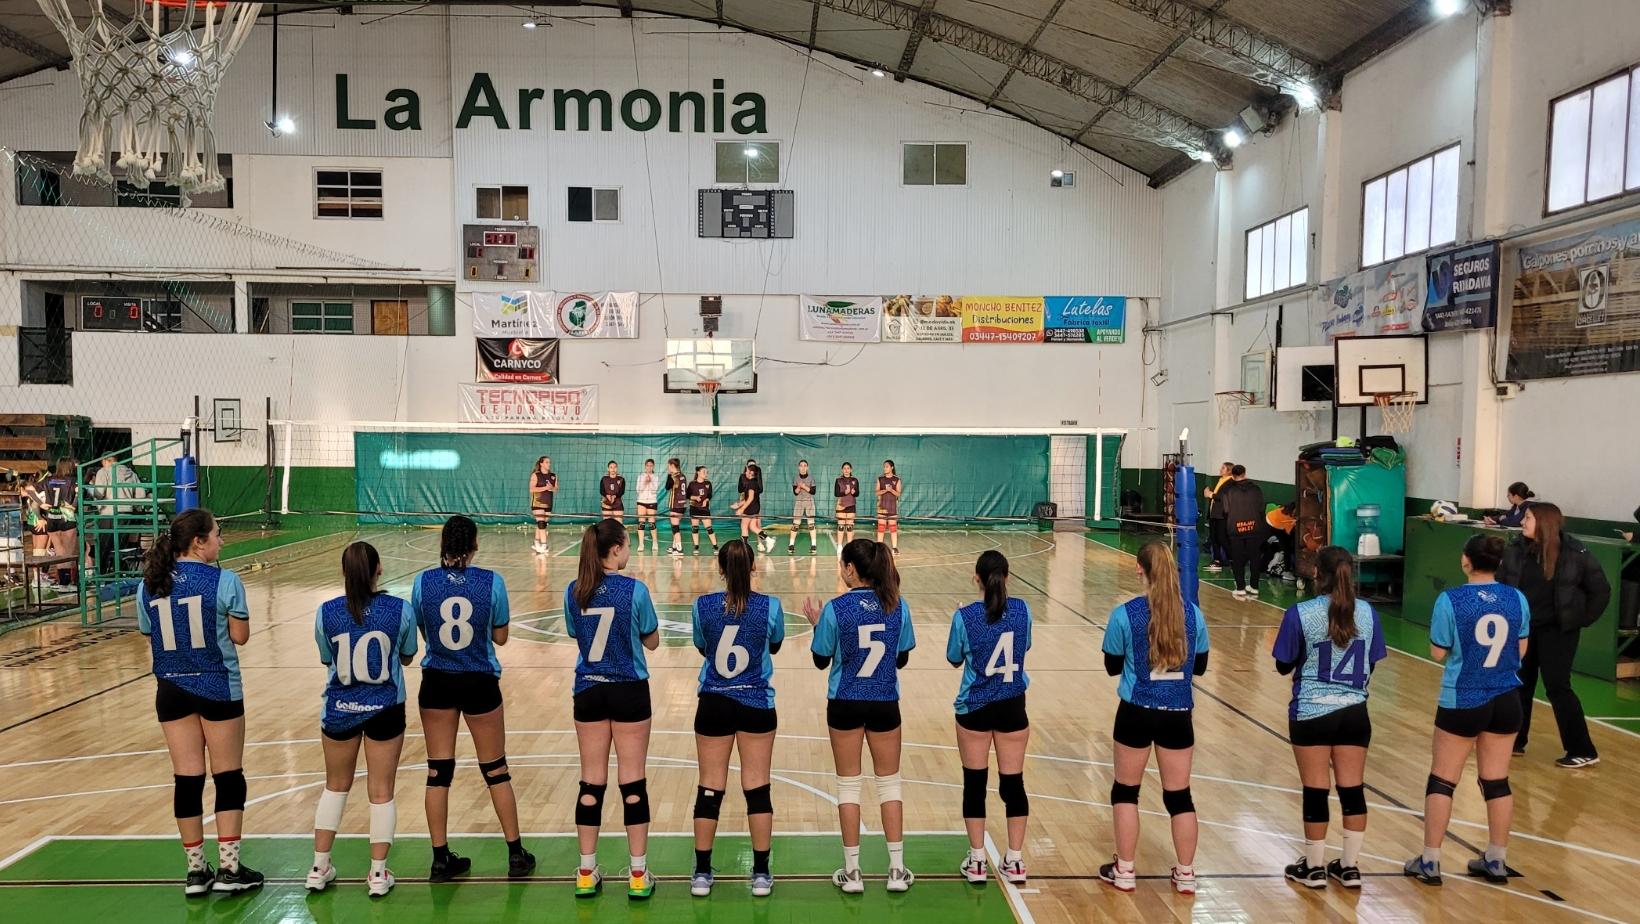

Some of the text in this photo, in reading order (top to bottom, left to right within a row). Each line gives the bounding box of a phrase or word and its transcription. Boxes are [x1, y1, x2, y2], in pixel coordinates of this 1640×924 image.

[335, 72, 768, 134] La Armonia
[1522, 250, 1568, 269] Galpones
[807, 304, 876, 316] LUNAMADERAS
[965, 302, 1042, 313] MONCHO BENITEZ
[972, 314, 1034, 325] Distribuciones
[493, 359, 542, 369] CARNYCO
[681, 484, 686, 496] 9
[150, 595, 207, 651] 11
[438, 596, 475, 651] 8
[581, 607, 616, 662] 7
[1475, 613, 1509, 669] 9
[331, 630, 392, 686] 10
[714, 624, 750, 679] 6
[856, 624, 886, 678] 5
[984, 631, 1019, 683] 4
[1312, 639, 1369, 689] 14
